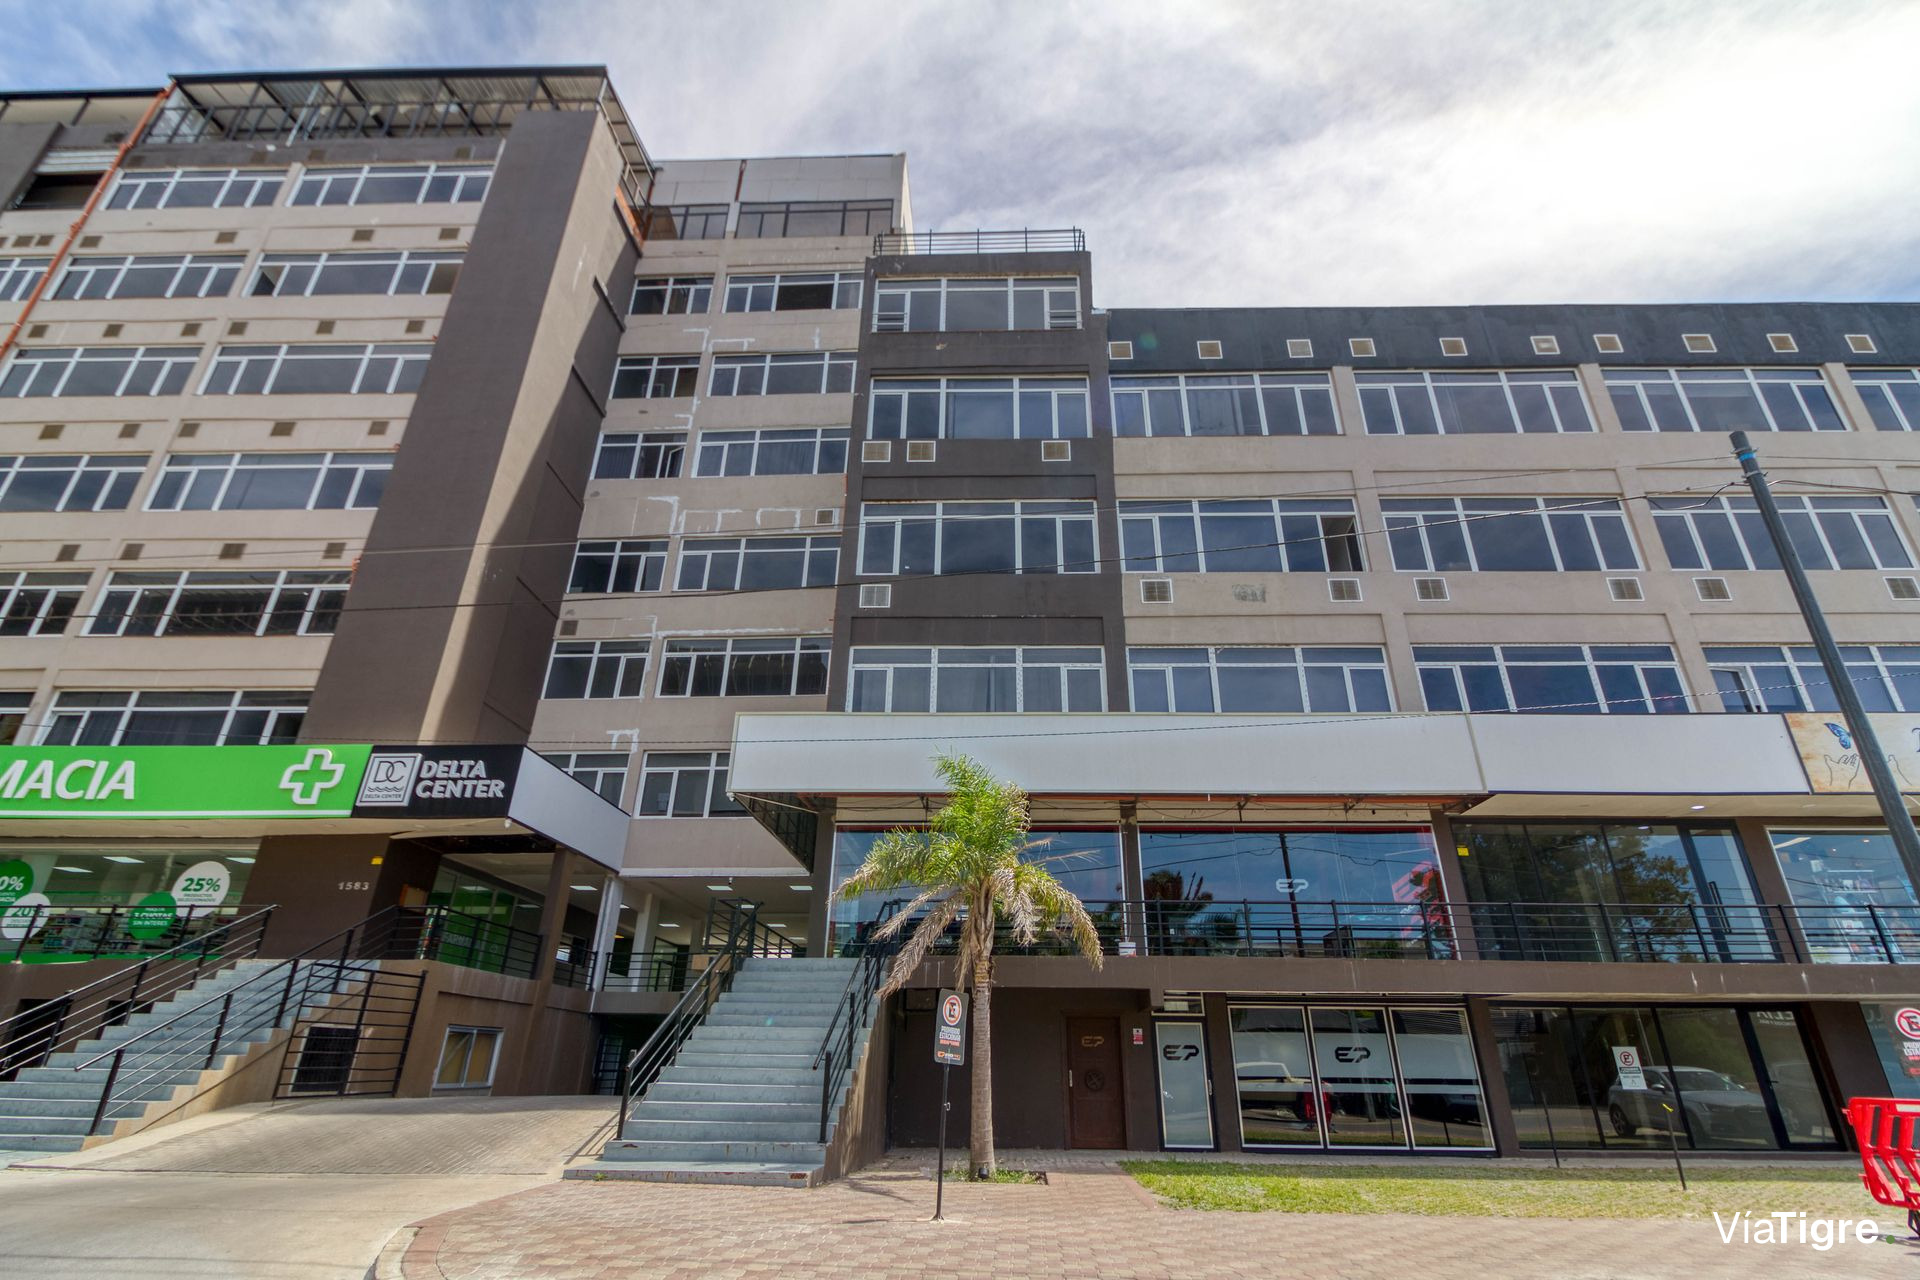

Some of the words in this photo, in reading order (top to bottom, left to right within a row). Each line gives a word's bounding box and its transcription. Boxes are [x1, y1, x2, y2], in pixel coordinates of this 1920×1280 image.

[418, 759, 487, 779] DELTA
[414, 779, 505, 799] CENTER
[181, 878, 221, 892] 25%
[338, 881, 370, 890] 1583
